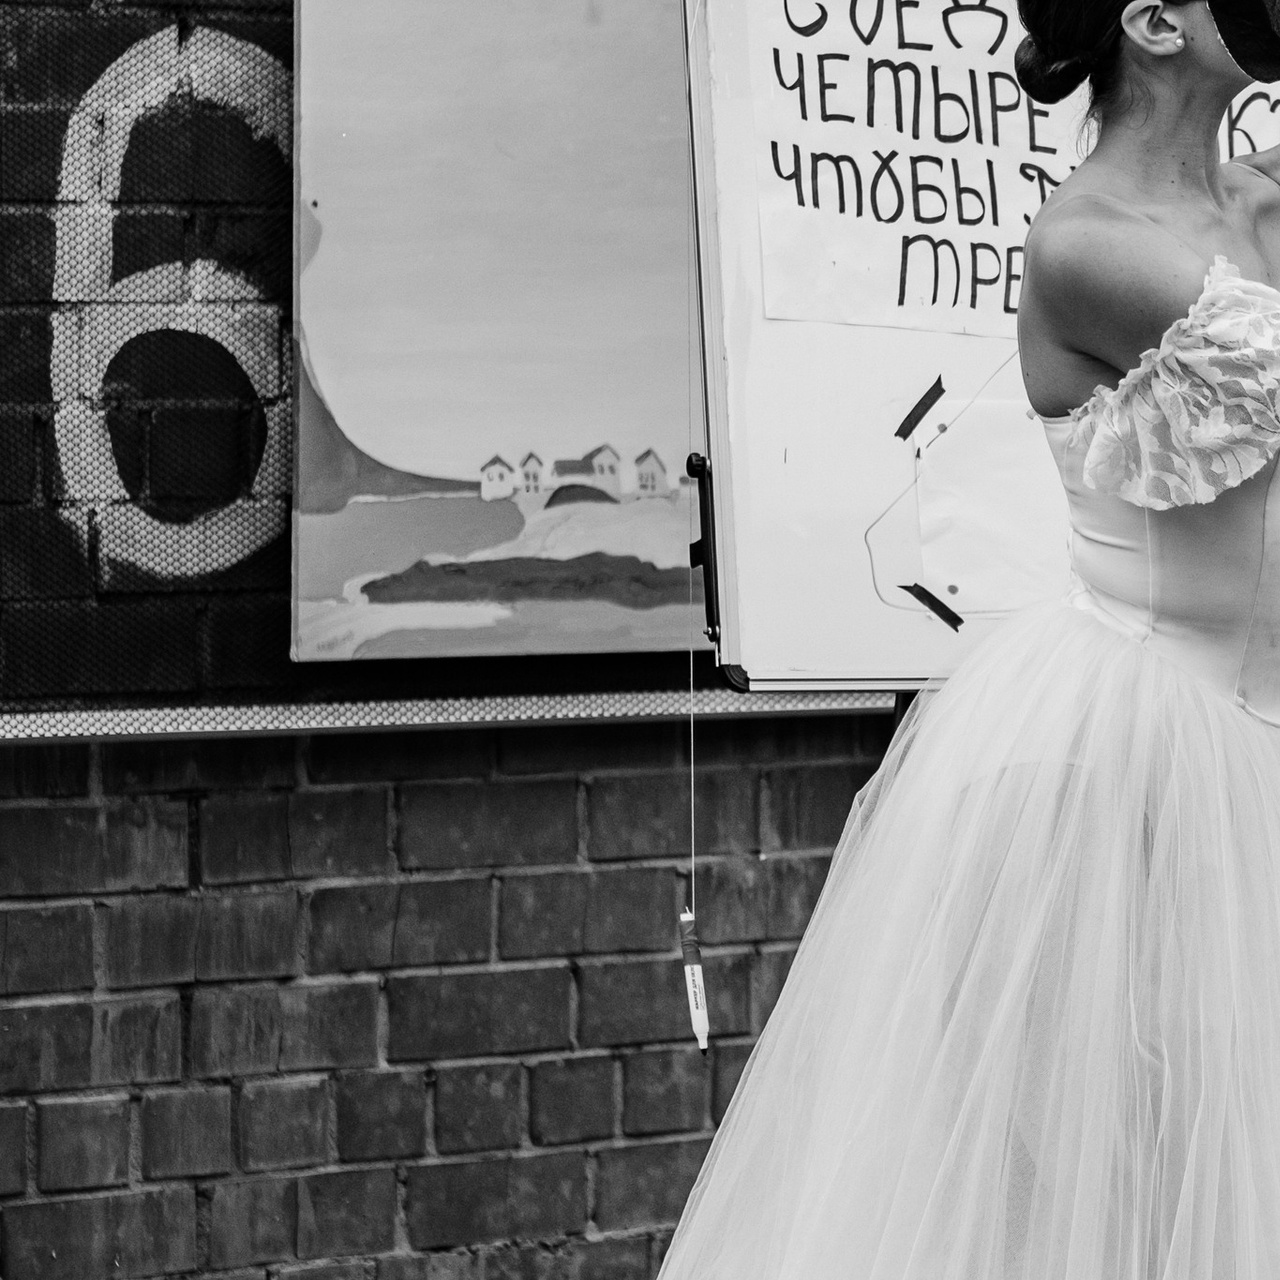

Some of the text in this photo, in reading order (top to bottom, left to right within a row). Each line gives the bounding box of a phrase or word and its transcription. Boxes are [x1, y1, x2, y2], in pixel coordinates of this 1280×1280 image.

[772, 46, 1058, 156] ЧЕТЫРЕ
[770, 139, 1000, 227] ЧТОБЫ
[50, 23, 294, 578] 6
[899, 233, 1024, 315] ТРЕ
